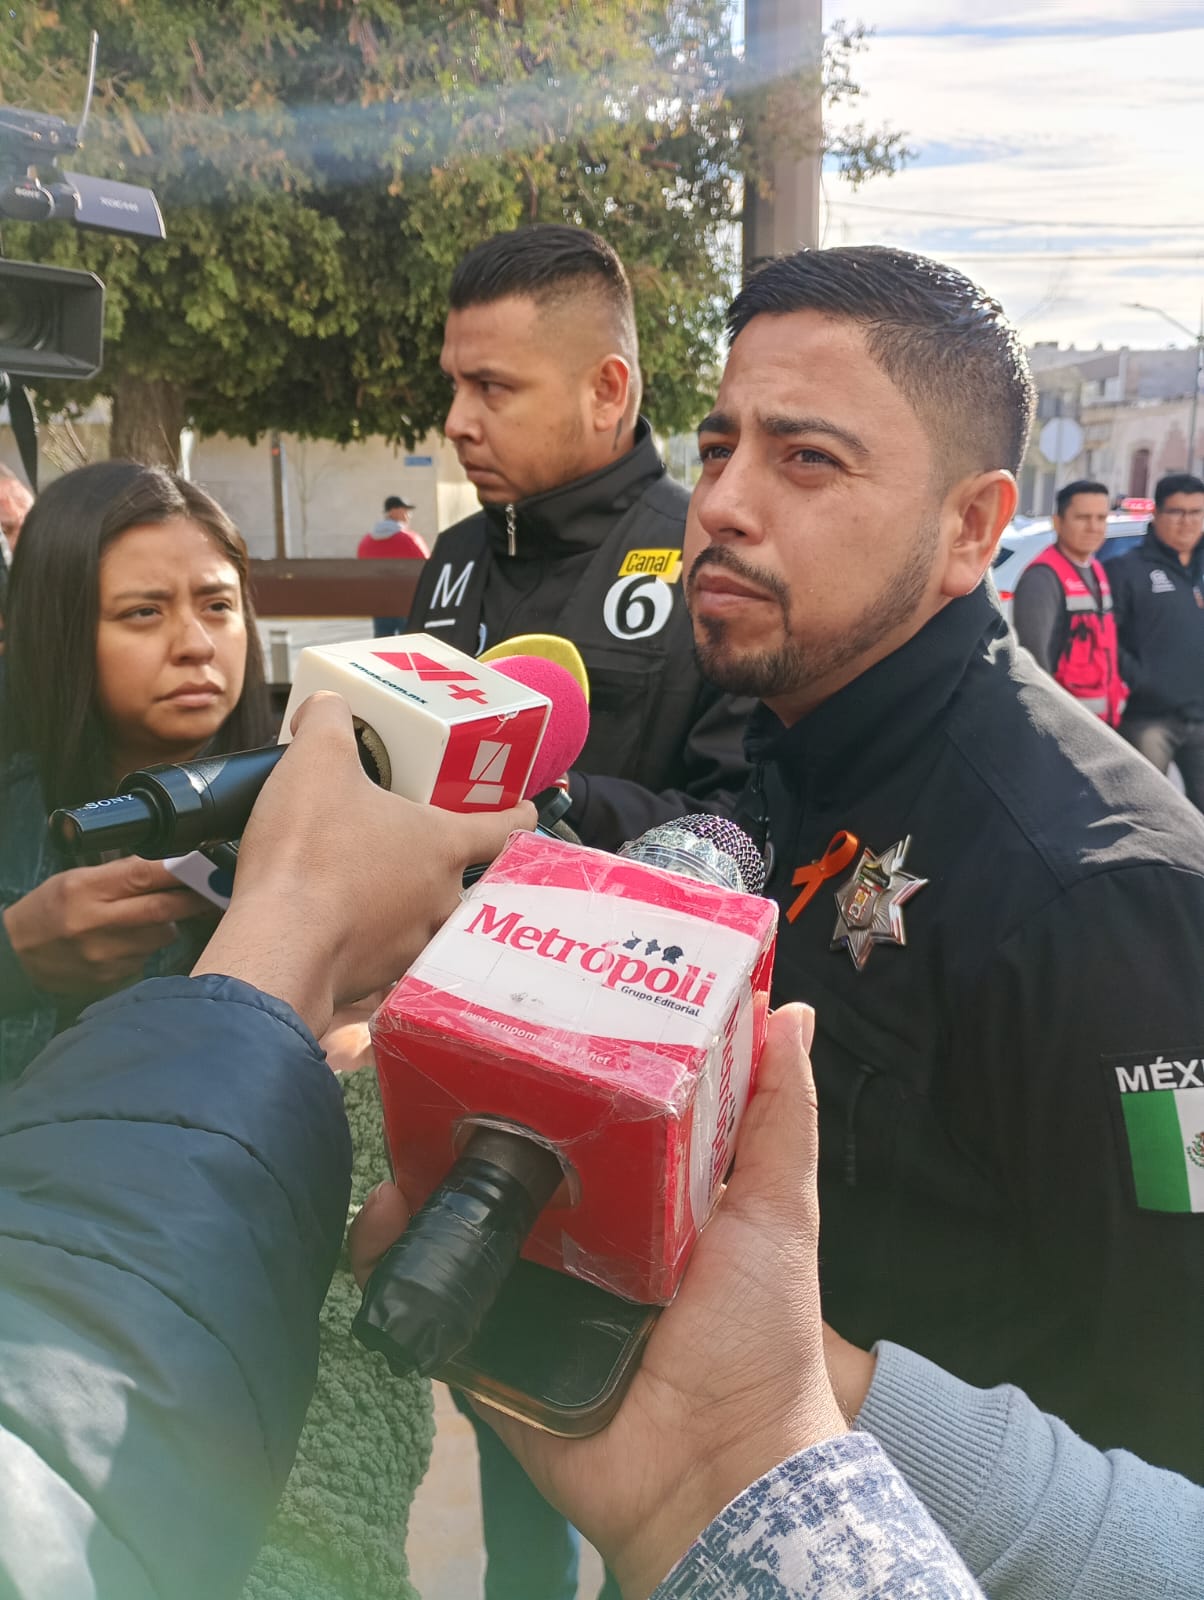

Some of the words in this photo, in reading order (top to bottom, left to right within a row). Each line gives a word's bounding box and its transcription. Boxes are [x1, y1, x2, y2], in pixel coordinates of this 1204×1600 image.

[625, 552, 671, 573] Canal
[429, 561, 475, 610] M
[615, 574, 657, 635] 6
[84, 794, 135, 809] SONY
[463, 903, 717, 1008] Metrópoli
[621, 985, 653, 1001] Grupo
[654, 996, 700, 1017] Editorial
[1115, 1056, 1204, 1093] MÉX
